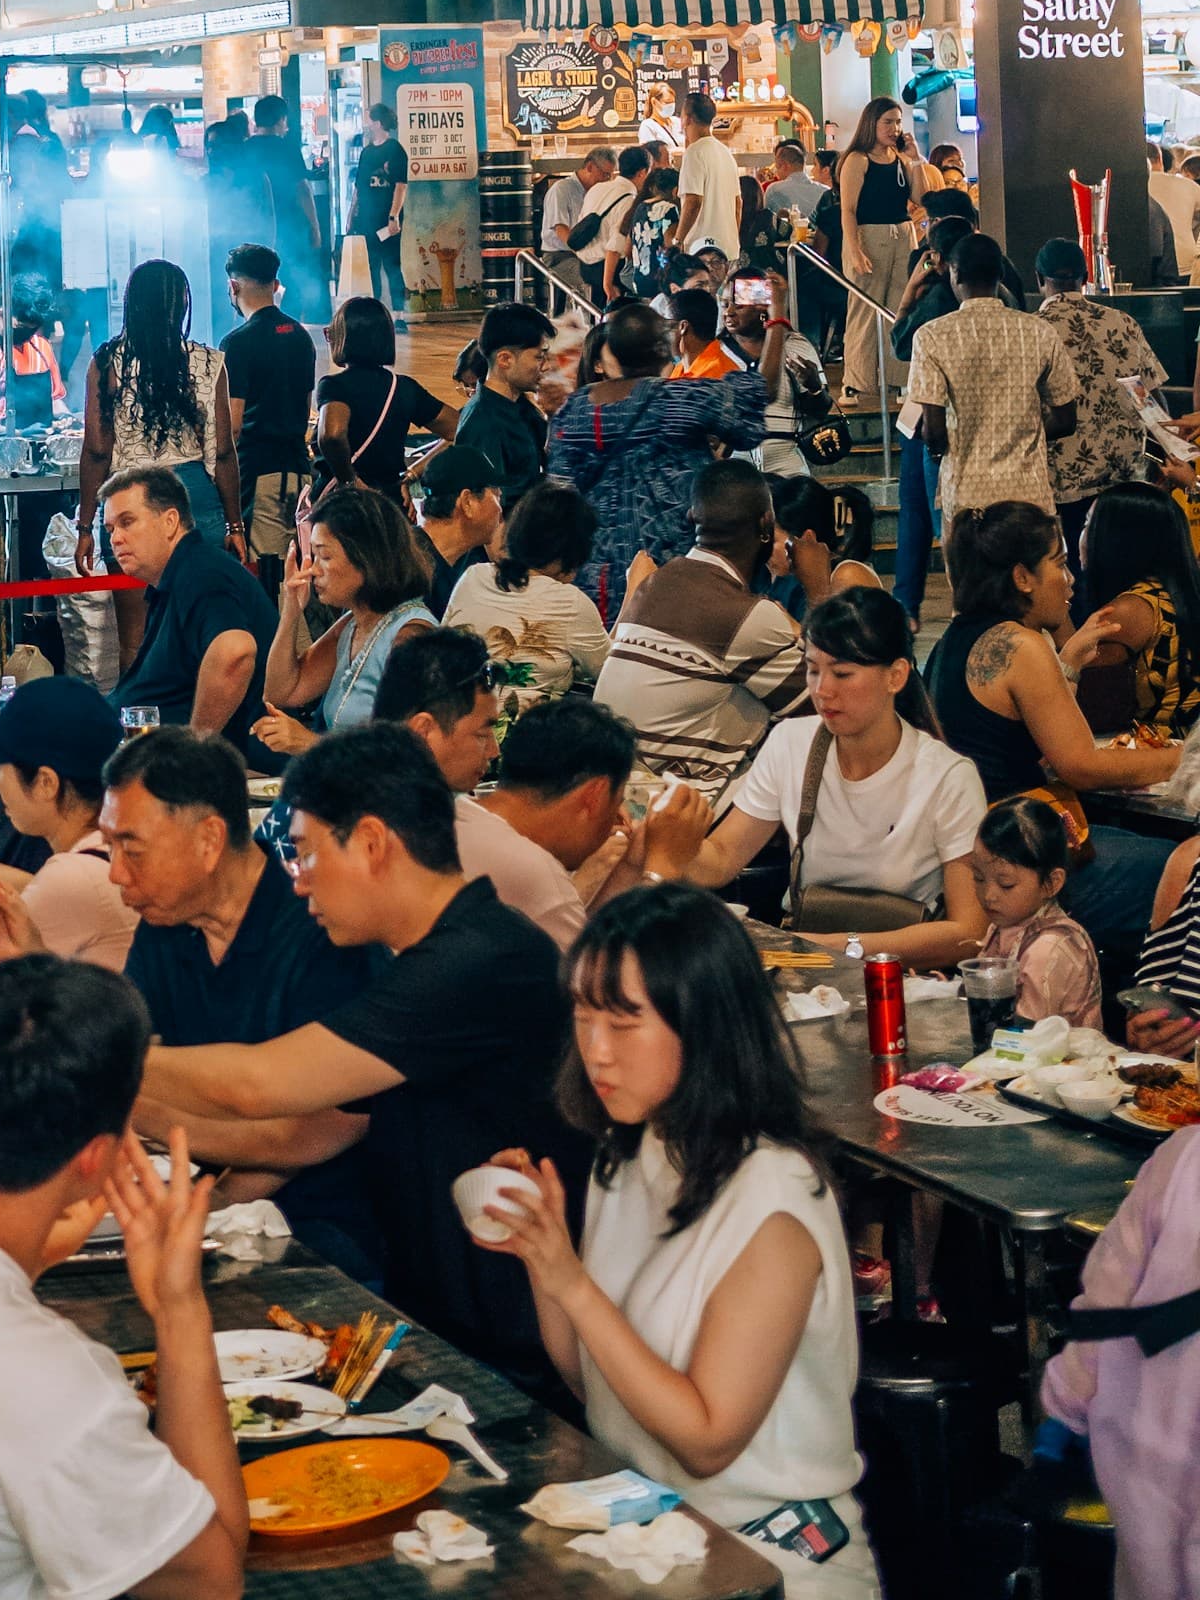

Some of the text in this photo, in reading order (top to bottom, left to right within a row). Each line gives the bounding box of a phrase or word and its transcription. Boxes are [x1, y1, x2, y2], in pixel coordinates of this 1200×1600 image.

[410, 38, 449, 51] ERDINGER
[1018, 25, 1125, 59] Street
[517, 69, 598, 87] LAGER & STOUT
[656, 69, 683, 81] Crystal
[407, 90, 428, 102] 7PM
[440, 90, 463, 102] 10PM
[409, 111, 464, 129] FRIDAYS
[420, 134, 438, 143] SEPT
[444, 134, 449, 143] 3
[453, 145, 466, 155] OCT
[423, 162, 468, 174] LAU PA SAT
[973, 1111, 1006, 1123] NO
